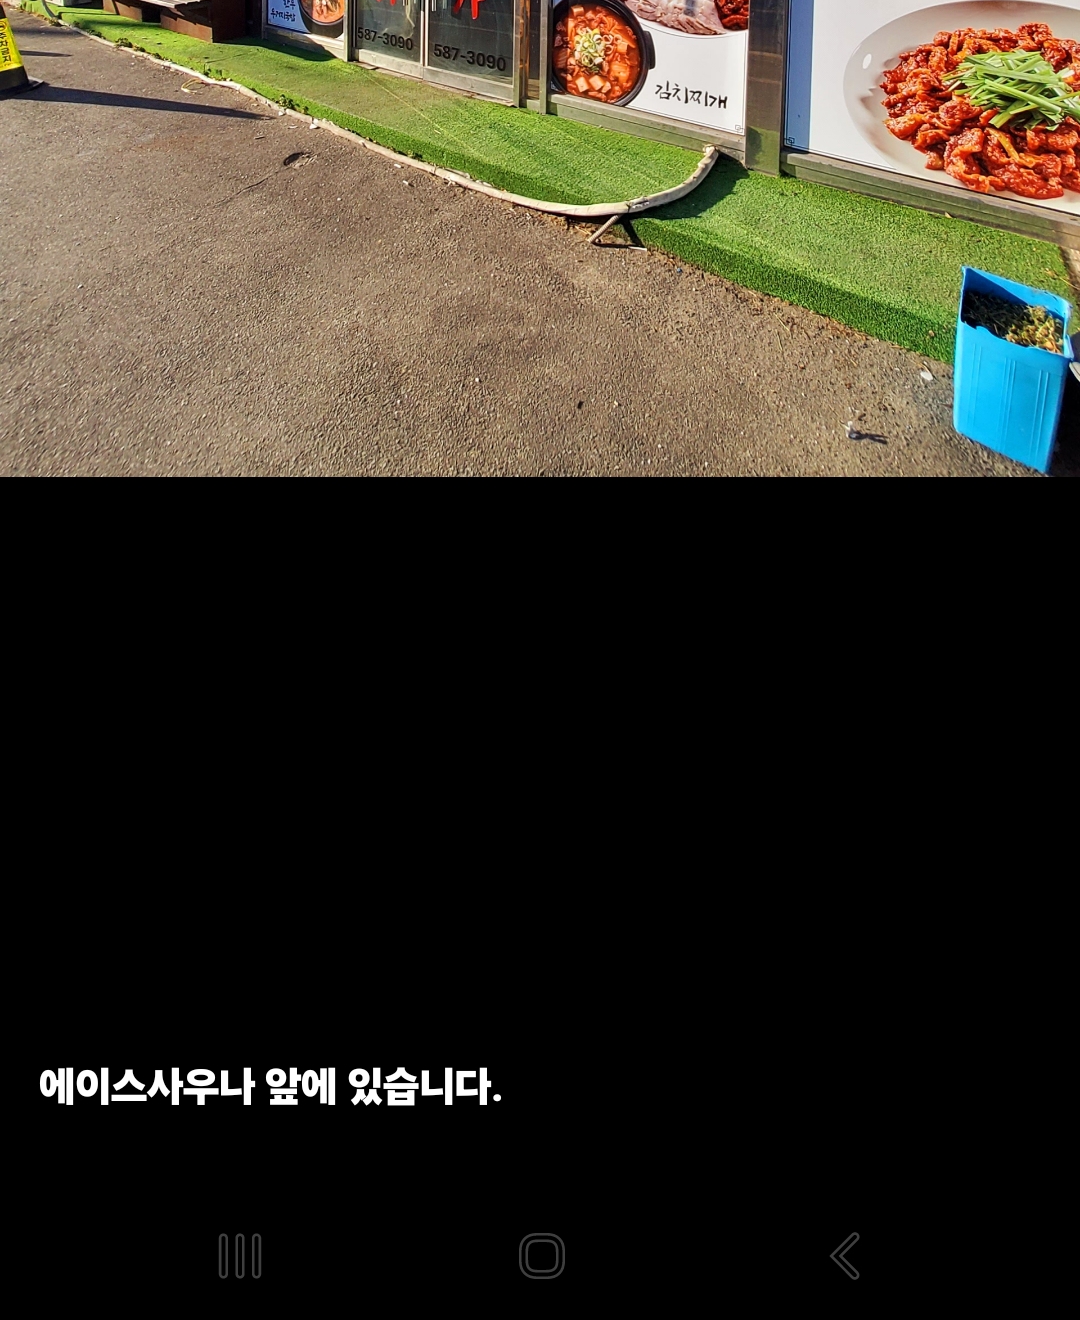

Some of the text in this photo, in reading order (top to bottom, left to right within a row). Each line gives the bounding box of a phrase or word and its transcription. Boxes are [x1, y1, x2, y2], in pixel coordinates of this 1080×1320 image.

[357, 27, 413, 51] 587-3090
[433, 43, 506, 72] 587-3090
[655, 81, 728, 109] 김치찌개
